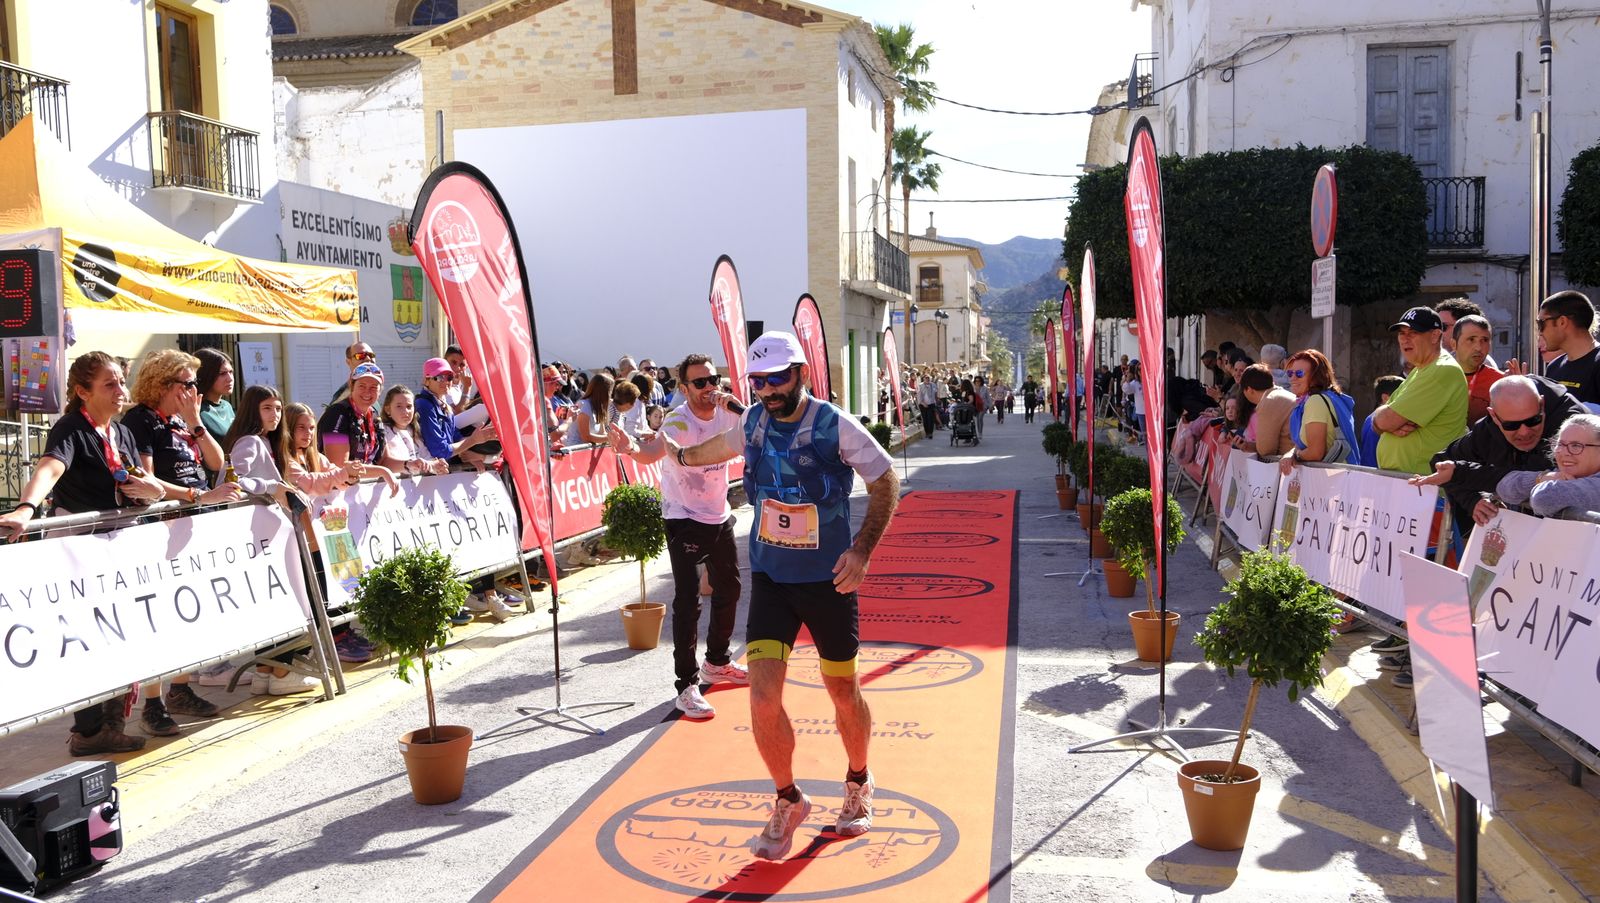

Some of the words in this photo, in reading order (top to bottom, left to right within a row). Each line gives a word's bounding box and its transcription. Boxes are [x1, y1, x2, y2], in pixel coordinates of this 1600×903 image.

[291, 209, 382, 242] EXCELENTÍSIMO
[81, 261, 97, 270] uno
[296, 241, 383, 270] AYUNTAMIENTO
[552, 472, 611, 514] VEOLIA
[365, 493, 477, 528] AYUNTAMIENTO
[485, 493, 499, 508] DE
[778, 514, 791, 529] 9
[369, 511, 509, 565] CANTORIA
[1397, 516, 1418, 537] DE
[1296, 517, 1415, 580] CANTORI
[0, 547, 237, 612] AYUNTAMIENTO
[246, 538, 272, 559] DE
[5, 564, 288, 668] CANTORIA
[1491, 587, 1600, 684] CANT
[885, 721, 920, 729] de
[671, 797, 842, 817] POVORA
[698, 791, 776, 801] antoria
[868, 805, 917, 819] LA
